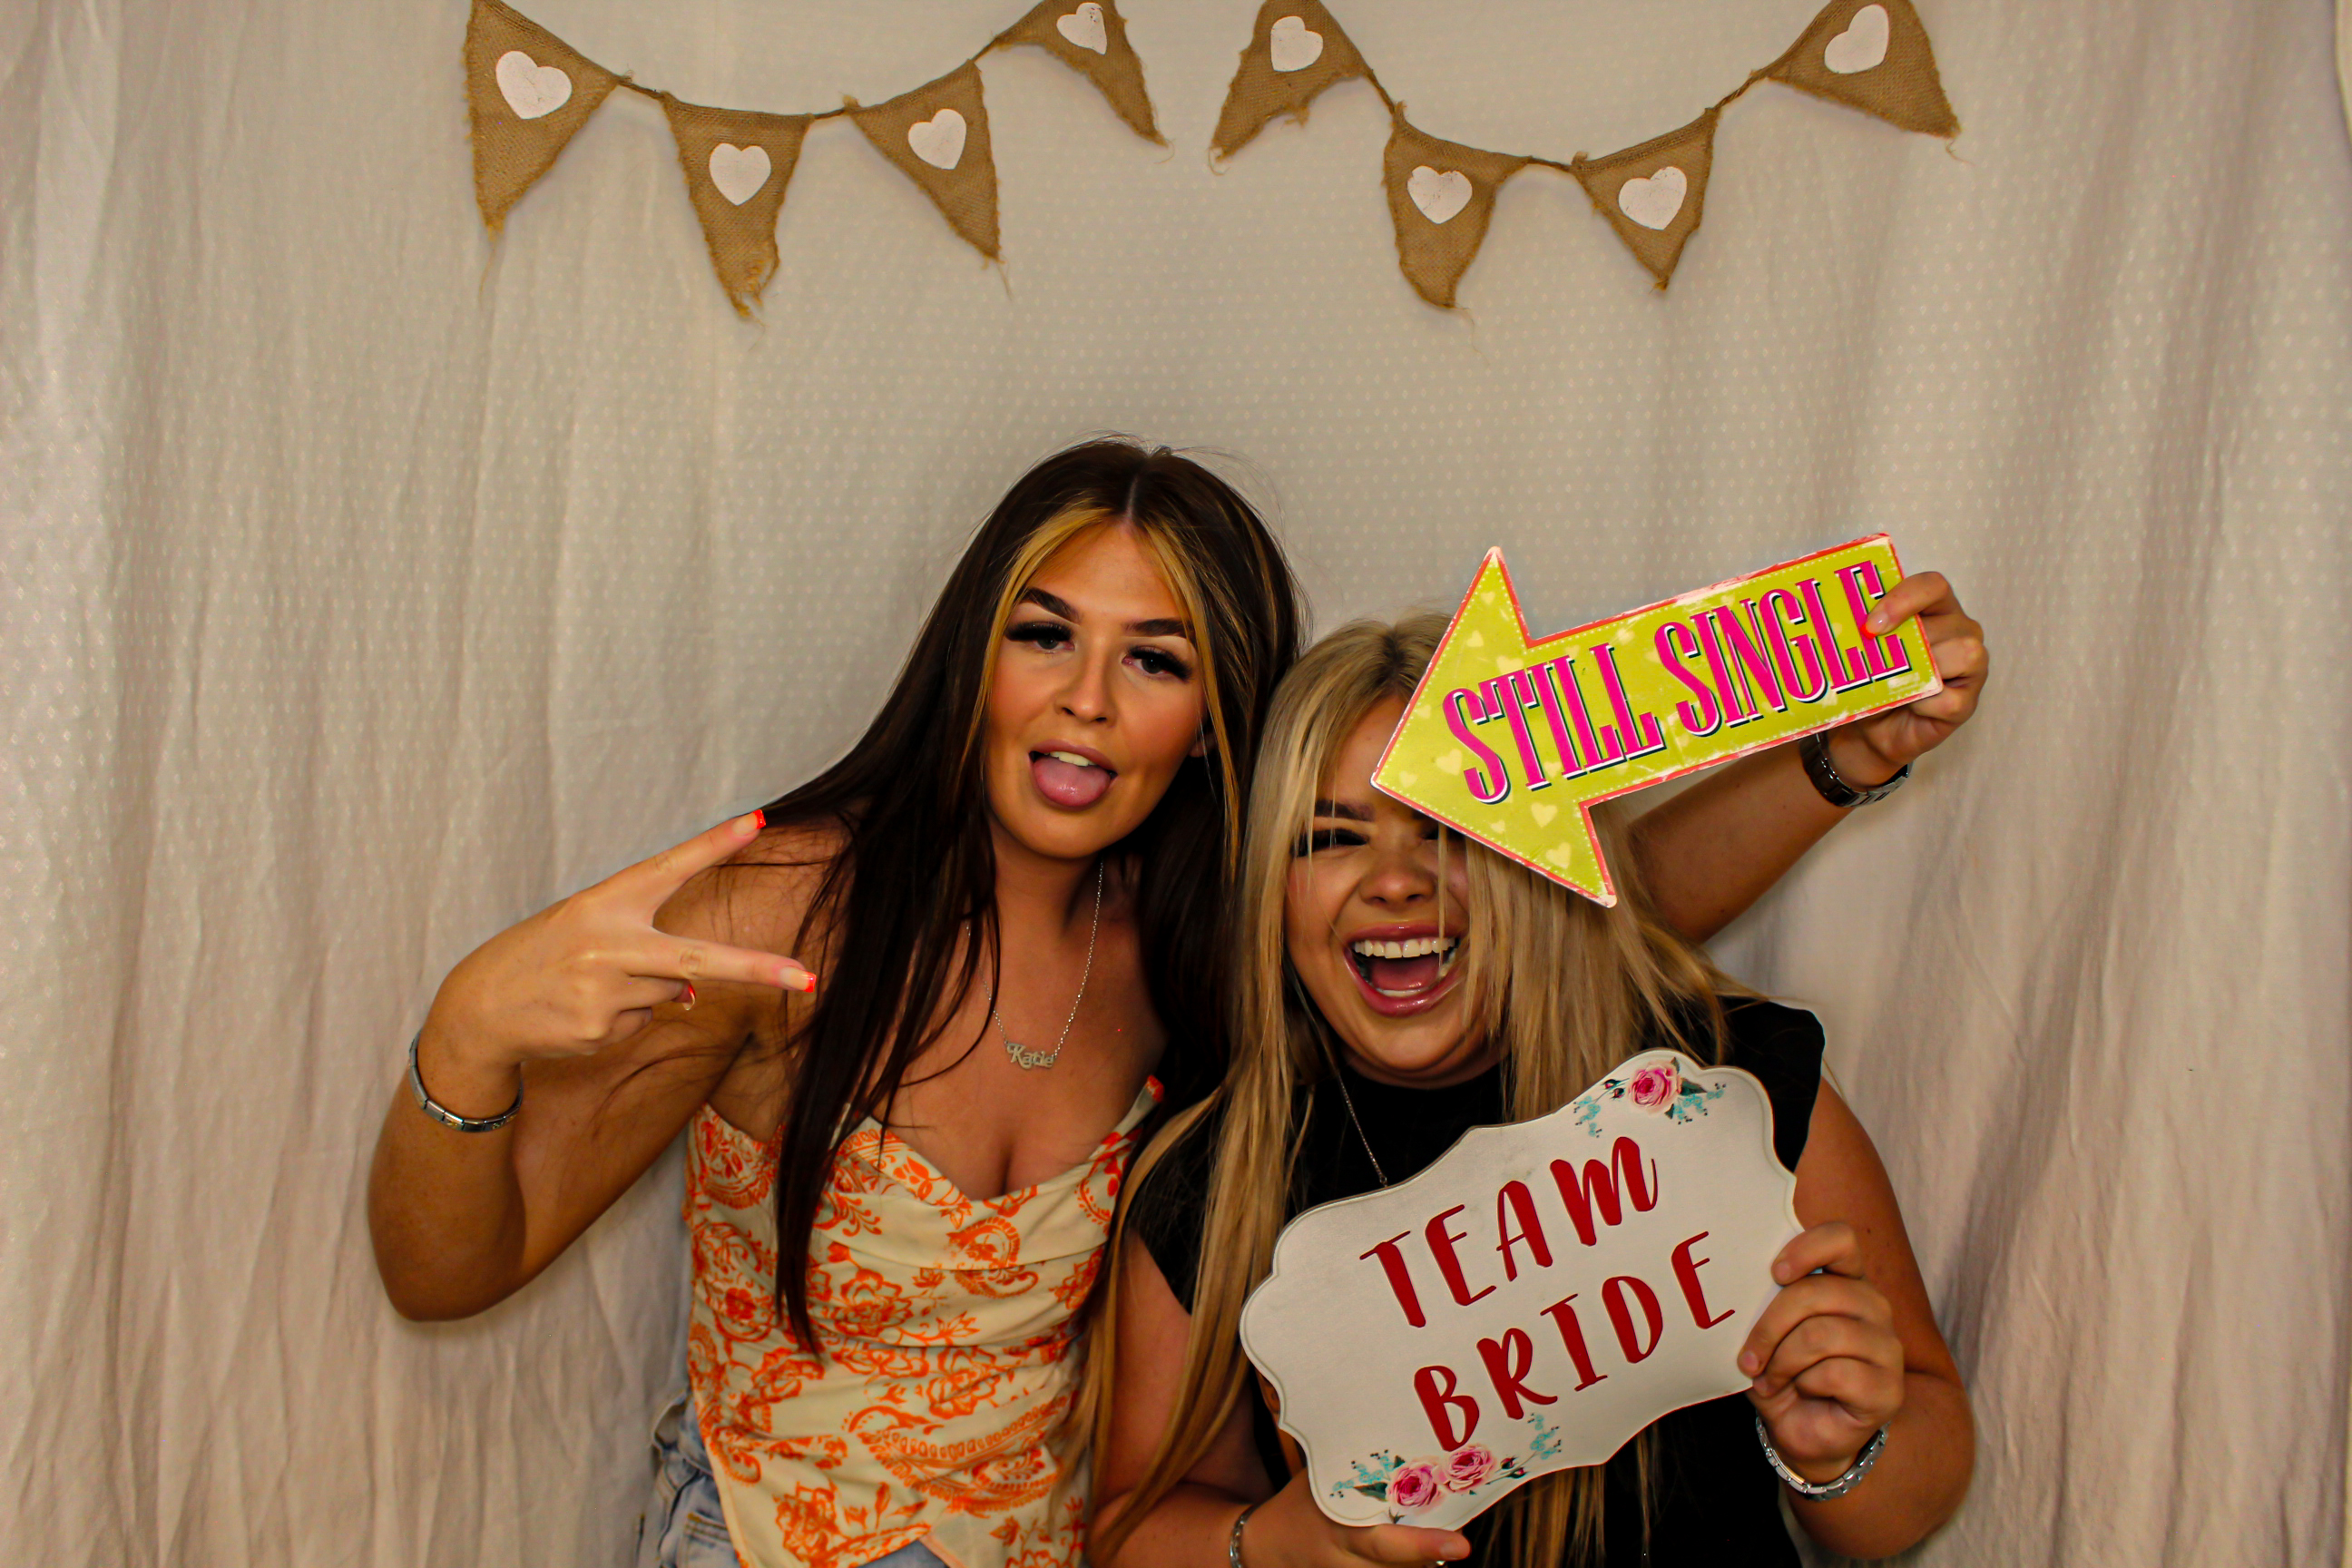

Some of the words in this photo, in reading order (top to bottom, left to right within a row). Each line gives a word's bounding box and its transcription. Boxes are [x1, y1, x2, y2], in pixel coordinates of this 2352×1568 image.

[1443, 642, 1664, 805] STILL
[1653, 560, 1912, 738] SINGLE
[1359, 1136, 1659, 1328] TEAM
[1414, 1231, 1735, 1451] BRIDE
